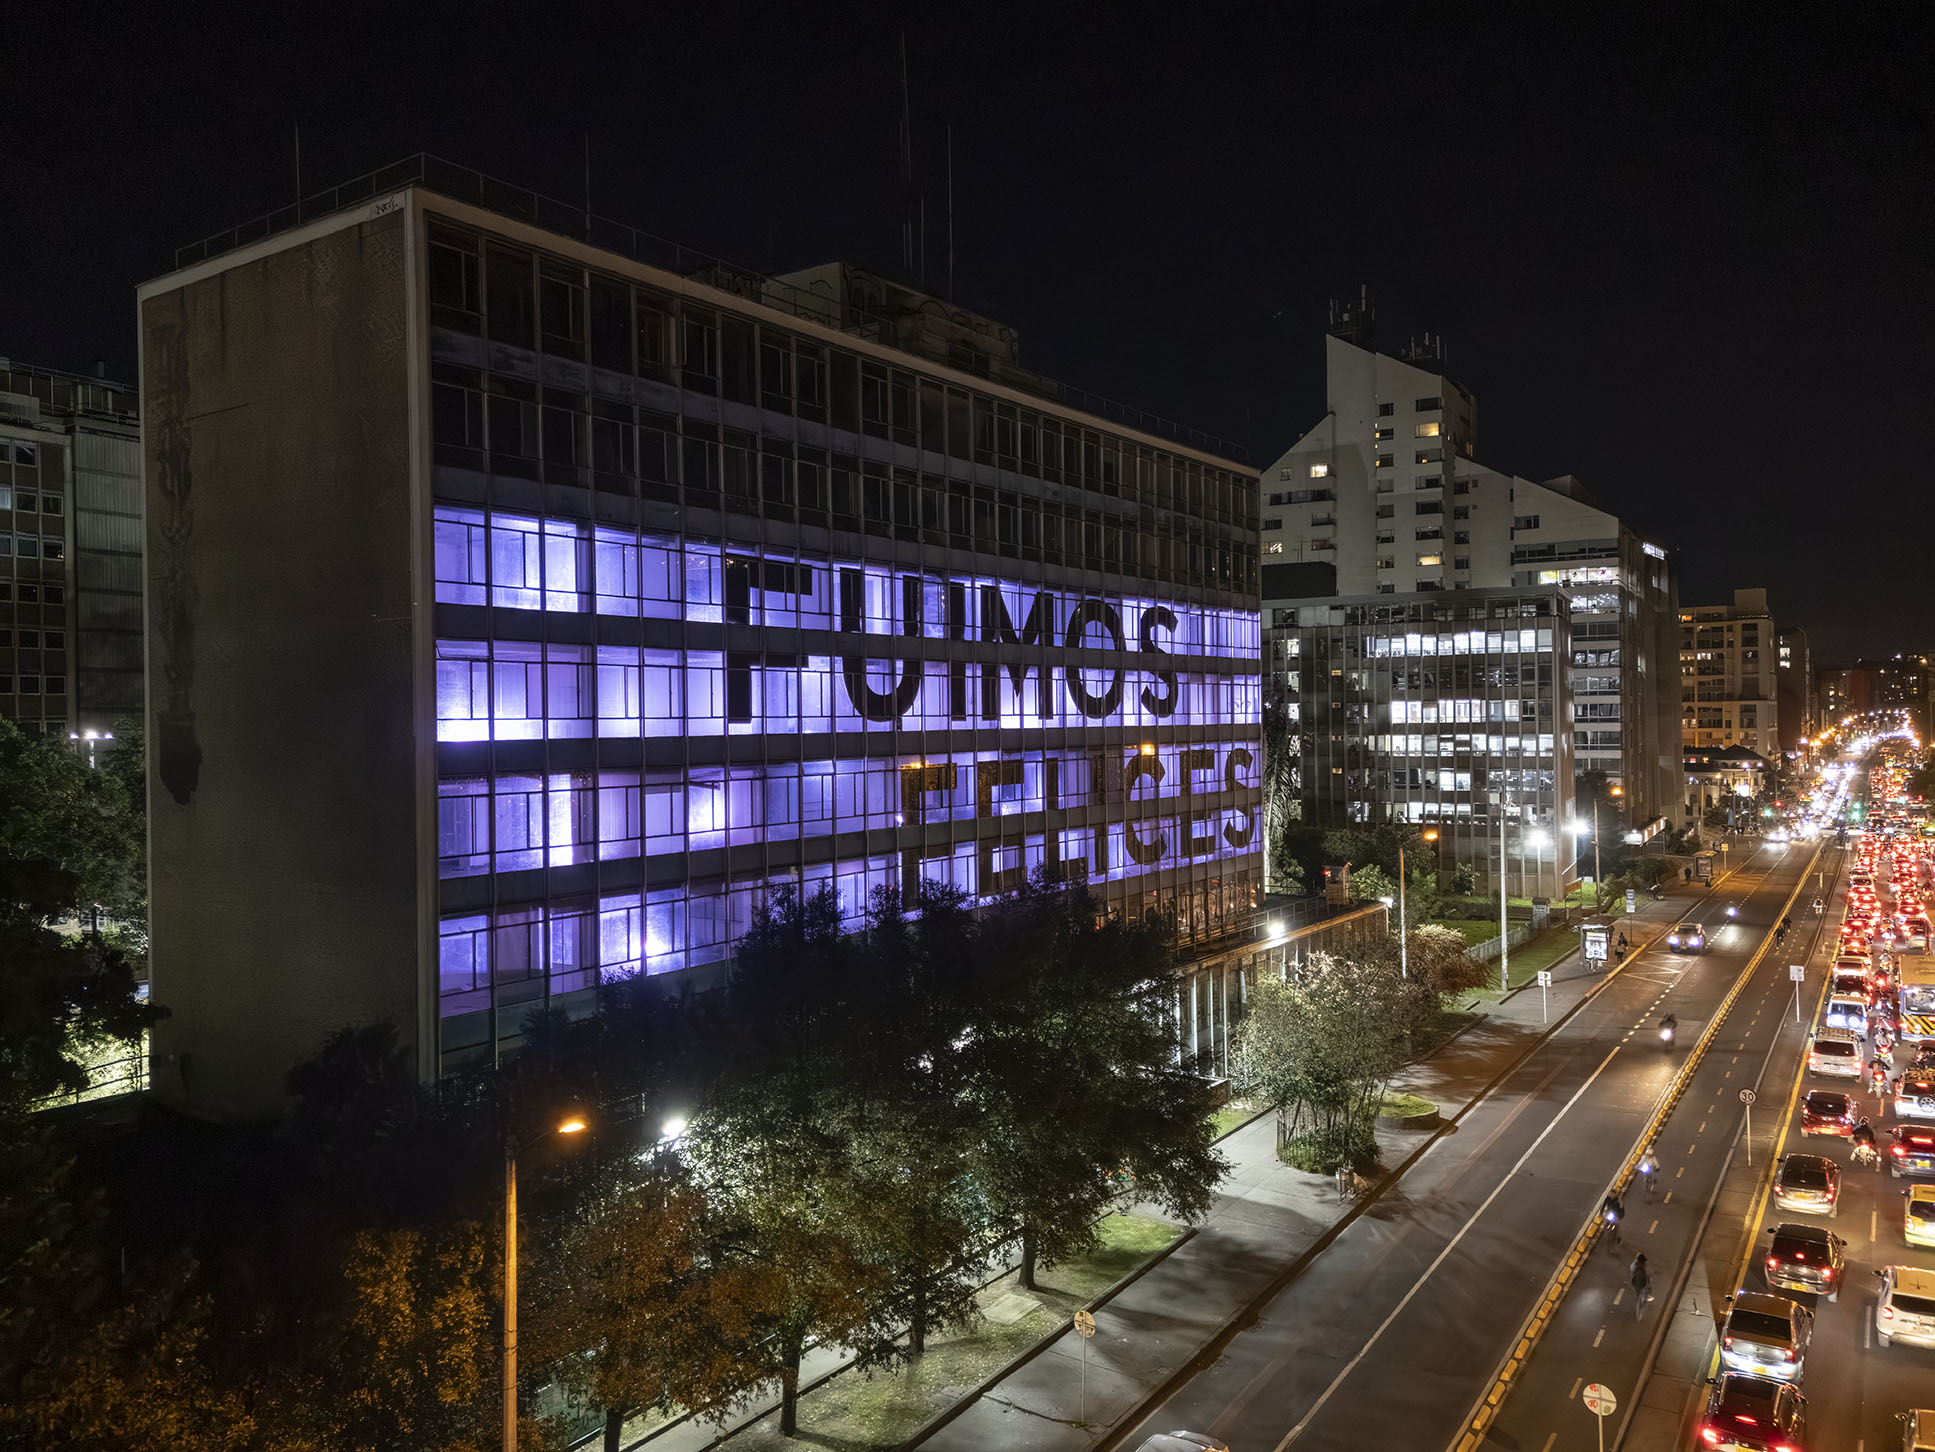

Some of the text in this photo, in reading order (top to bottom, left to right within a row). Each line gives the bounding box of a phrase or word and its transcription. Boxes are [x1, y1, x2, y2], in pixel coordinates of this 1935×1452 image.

[726, 553, 1179, 723] FUIMOS
[900, 747, 1254, 912] FELICES
[1741, 1092, 1754, 1101] 30
